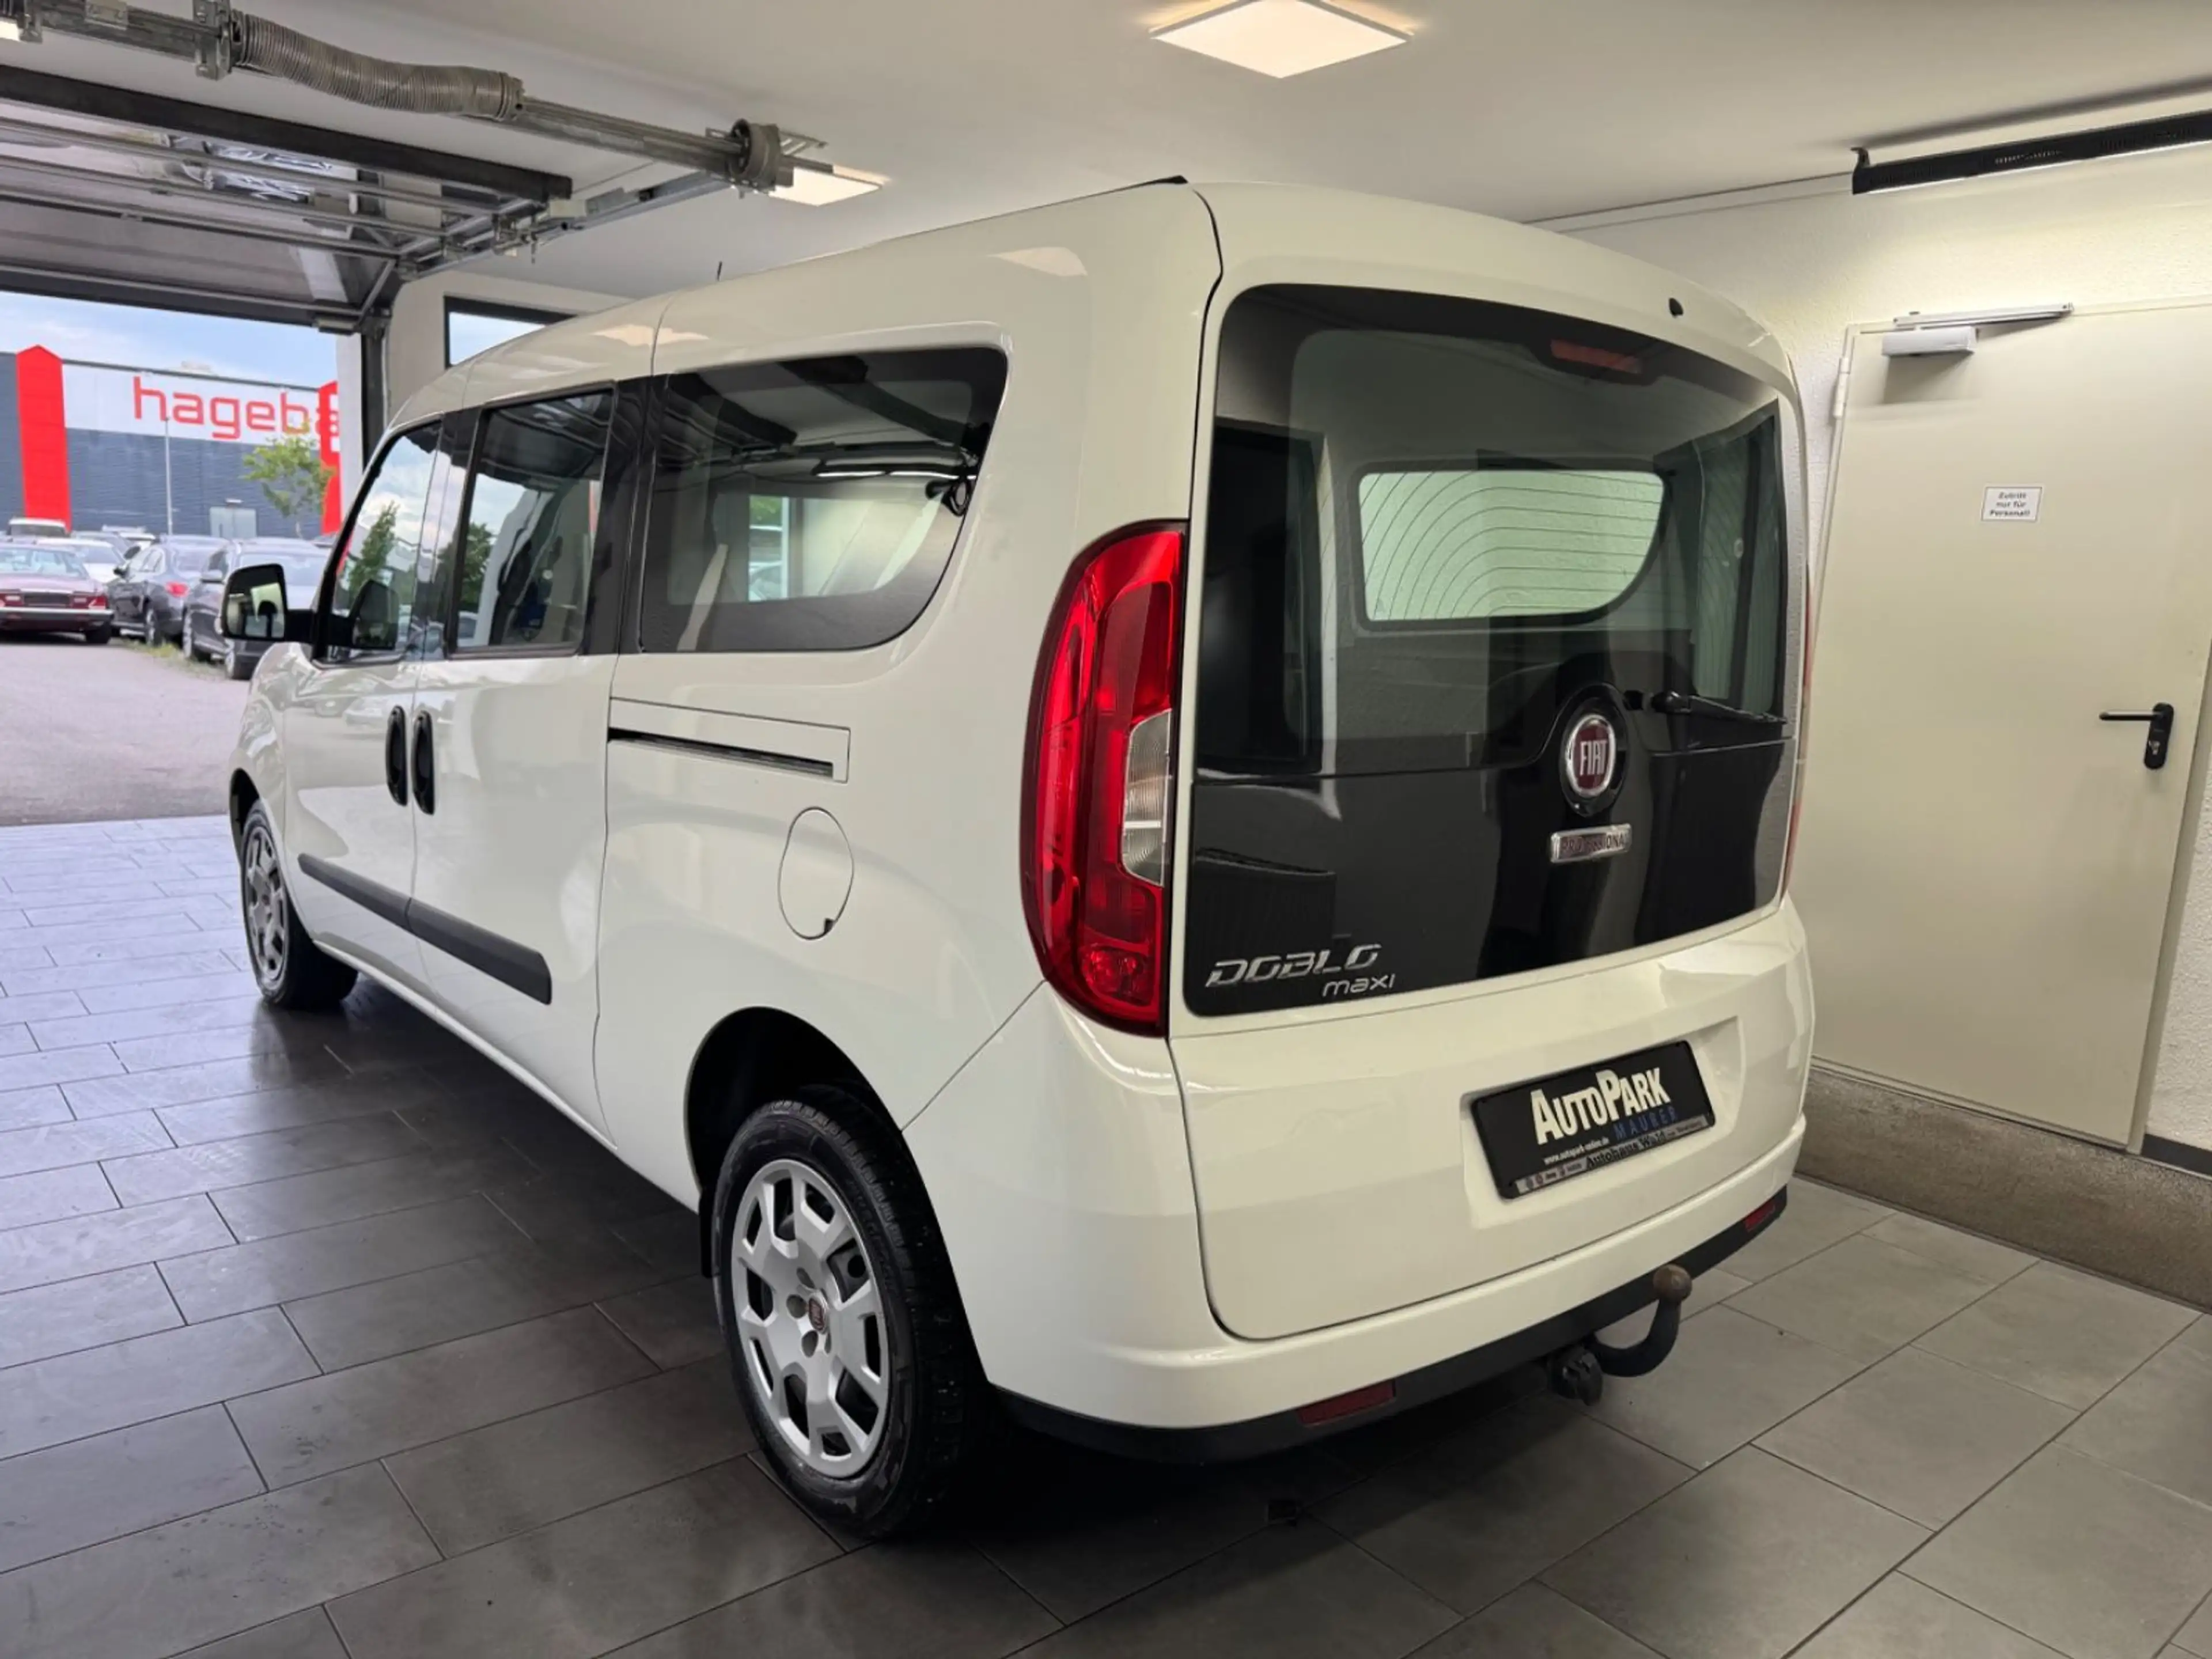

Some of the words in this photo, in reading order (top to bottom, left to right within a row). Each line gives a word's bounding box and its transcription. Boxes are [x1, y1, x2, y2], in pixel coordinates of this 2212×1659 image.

[1580, 740, 1607, 776] FIAT
[1206, 944, 1381, 987] DOBLO
[1323, 974, 1395, 996] maxi
